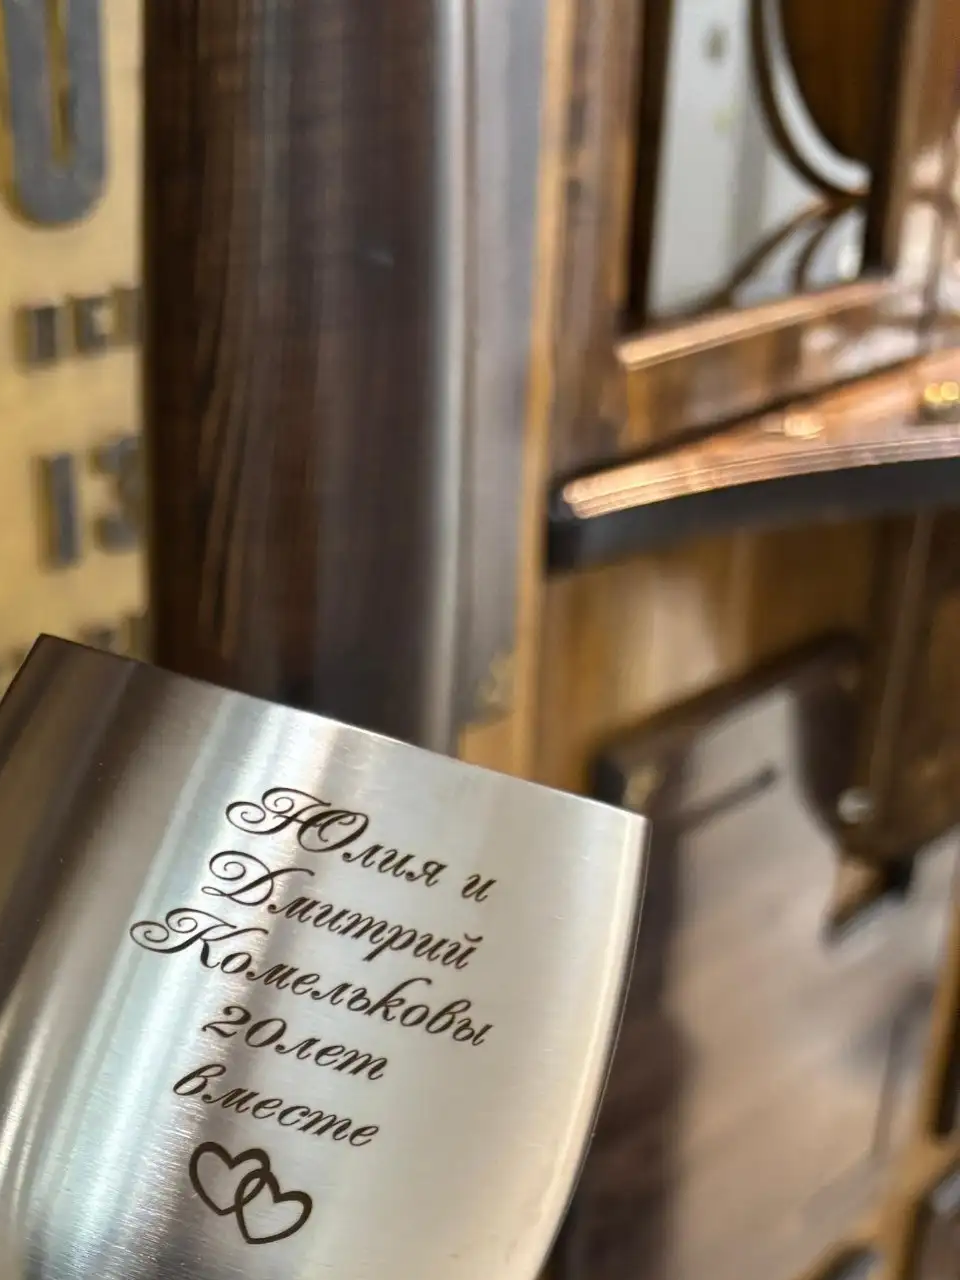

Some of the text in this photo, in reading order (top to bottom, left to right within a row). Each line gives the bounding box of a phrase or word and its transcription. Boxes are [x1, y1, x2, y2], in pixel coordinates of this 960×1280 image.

[225, 787, 496, 903] Юлия и
[201, 850, 484, 970] Дмитрий
[129, 907, 494, 1047] Комельковы
[172, 1063, 380, 1147] вместе
